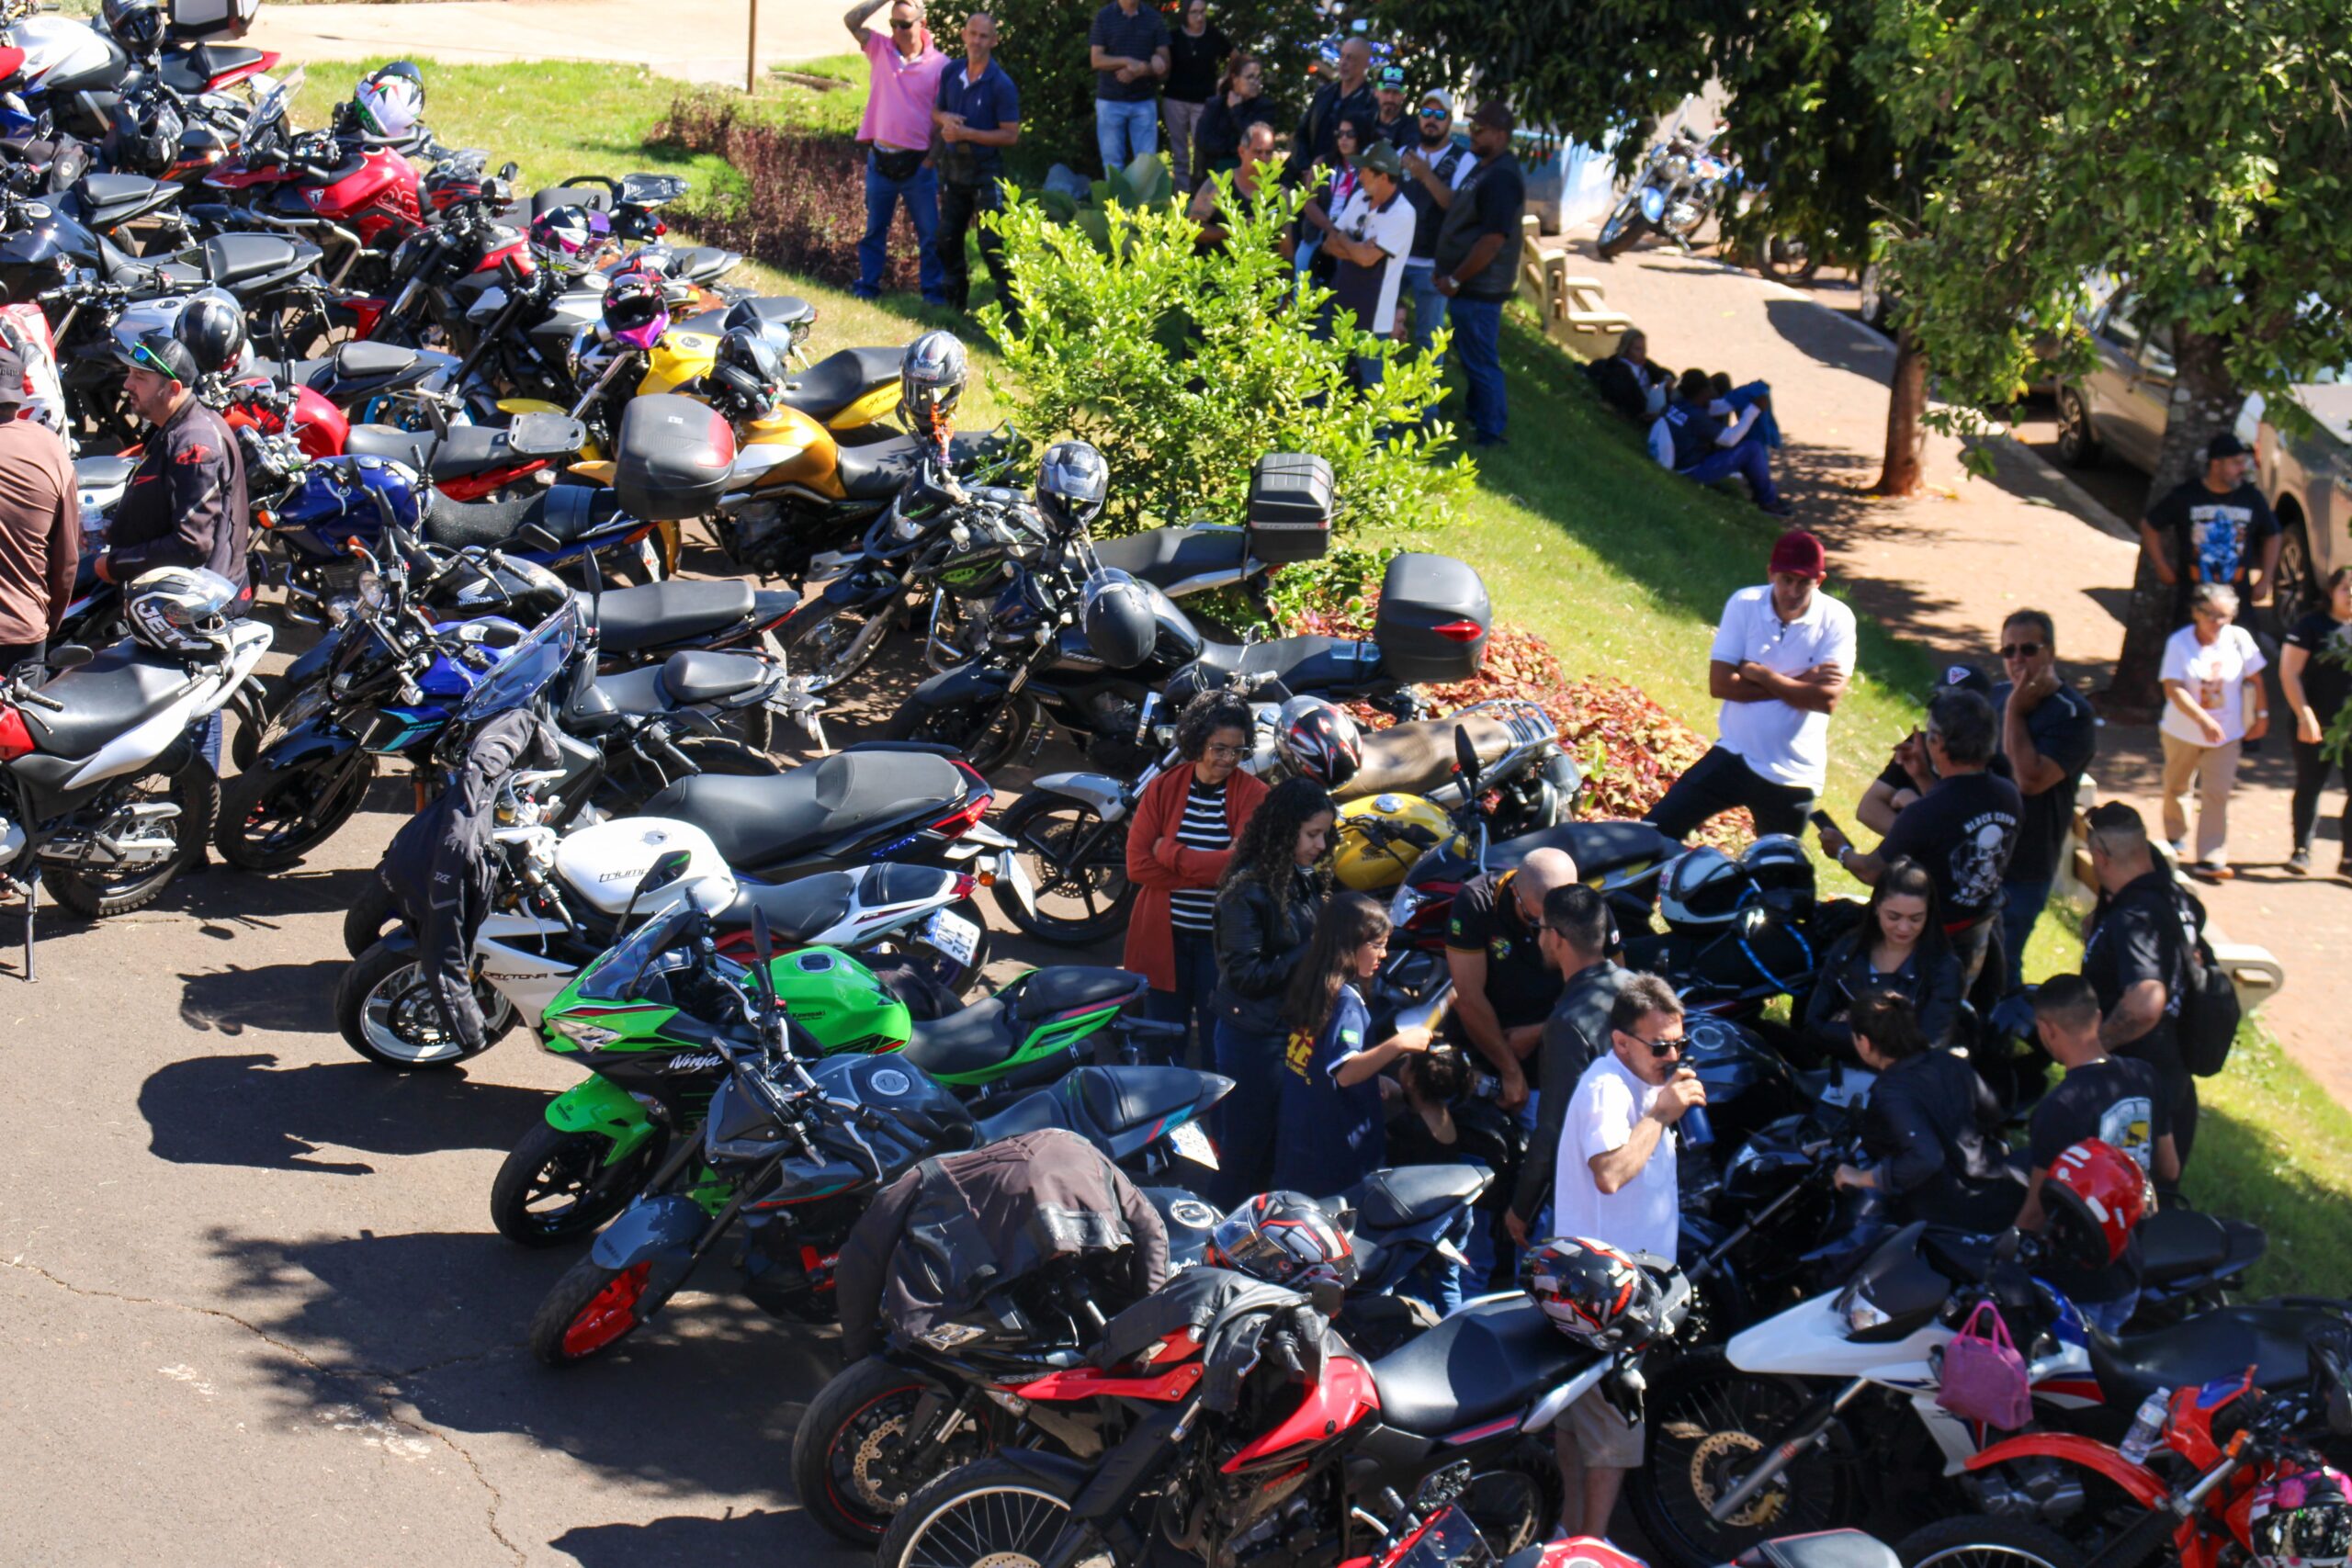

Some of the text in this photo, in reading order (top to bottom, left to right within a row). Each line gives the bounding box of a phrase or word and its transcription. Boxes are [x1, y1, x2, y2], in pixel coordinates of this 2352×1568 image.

[458, 595, 494, 606] HONDA
[483, 970, 548, 982] DAYTONA
[669, 1052, 723, 1073] Ninja
